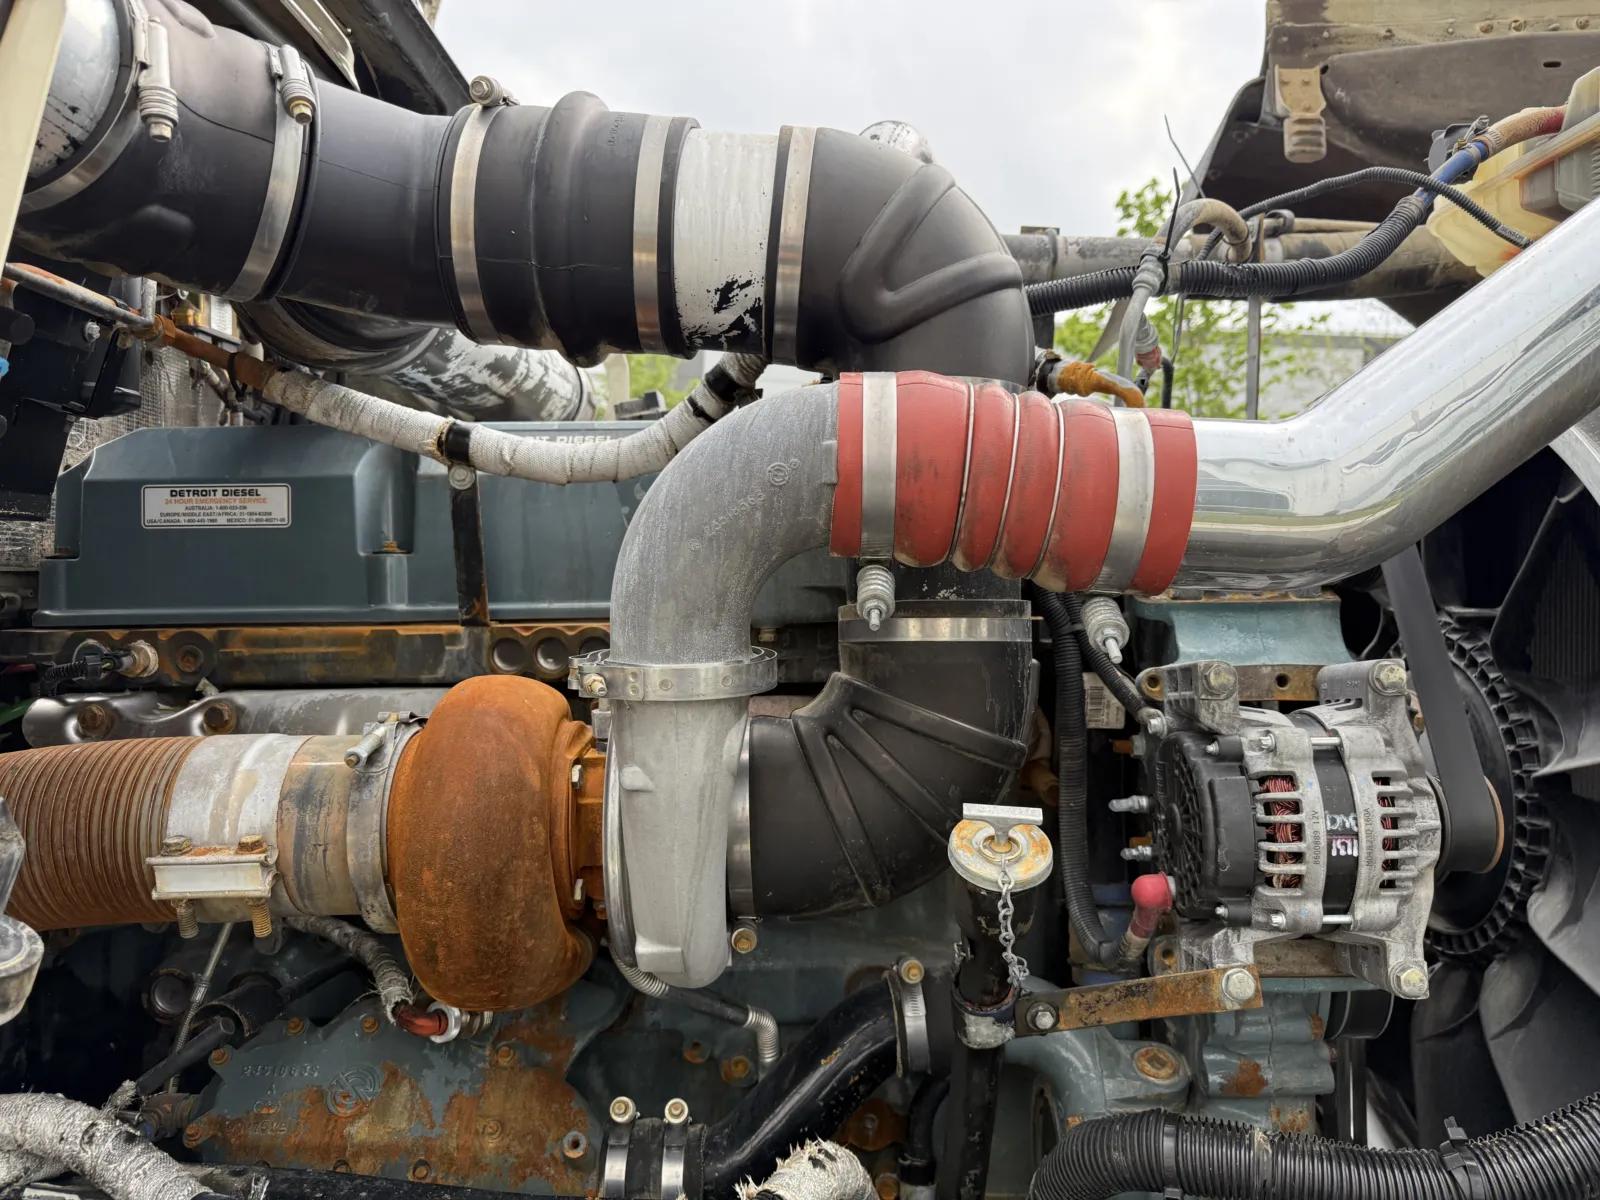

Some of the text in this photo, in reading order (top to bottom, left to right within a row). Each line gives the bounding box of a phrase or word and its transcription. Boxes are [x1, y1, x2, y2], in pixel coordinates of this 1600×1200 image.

[170, 488, 261, 497] DETROIT DIESEL
[1311, 810, 1319, 825] 12V
